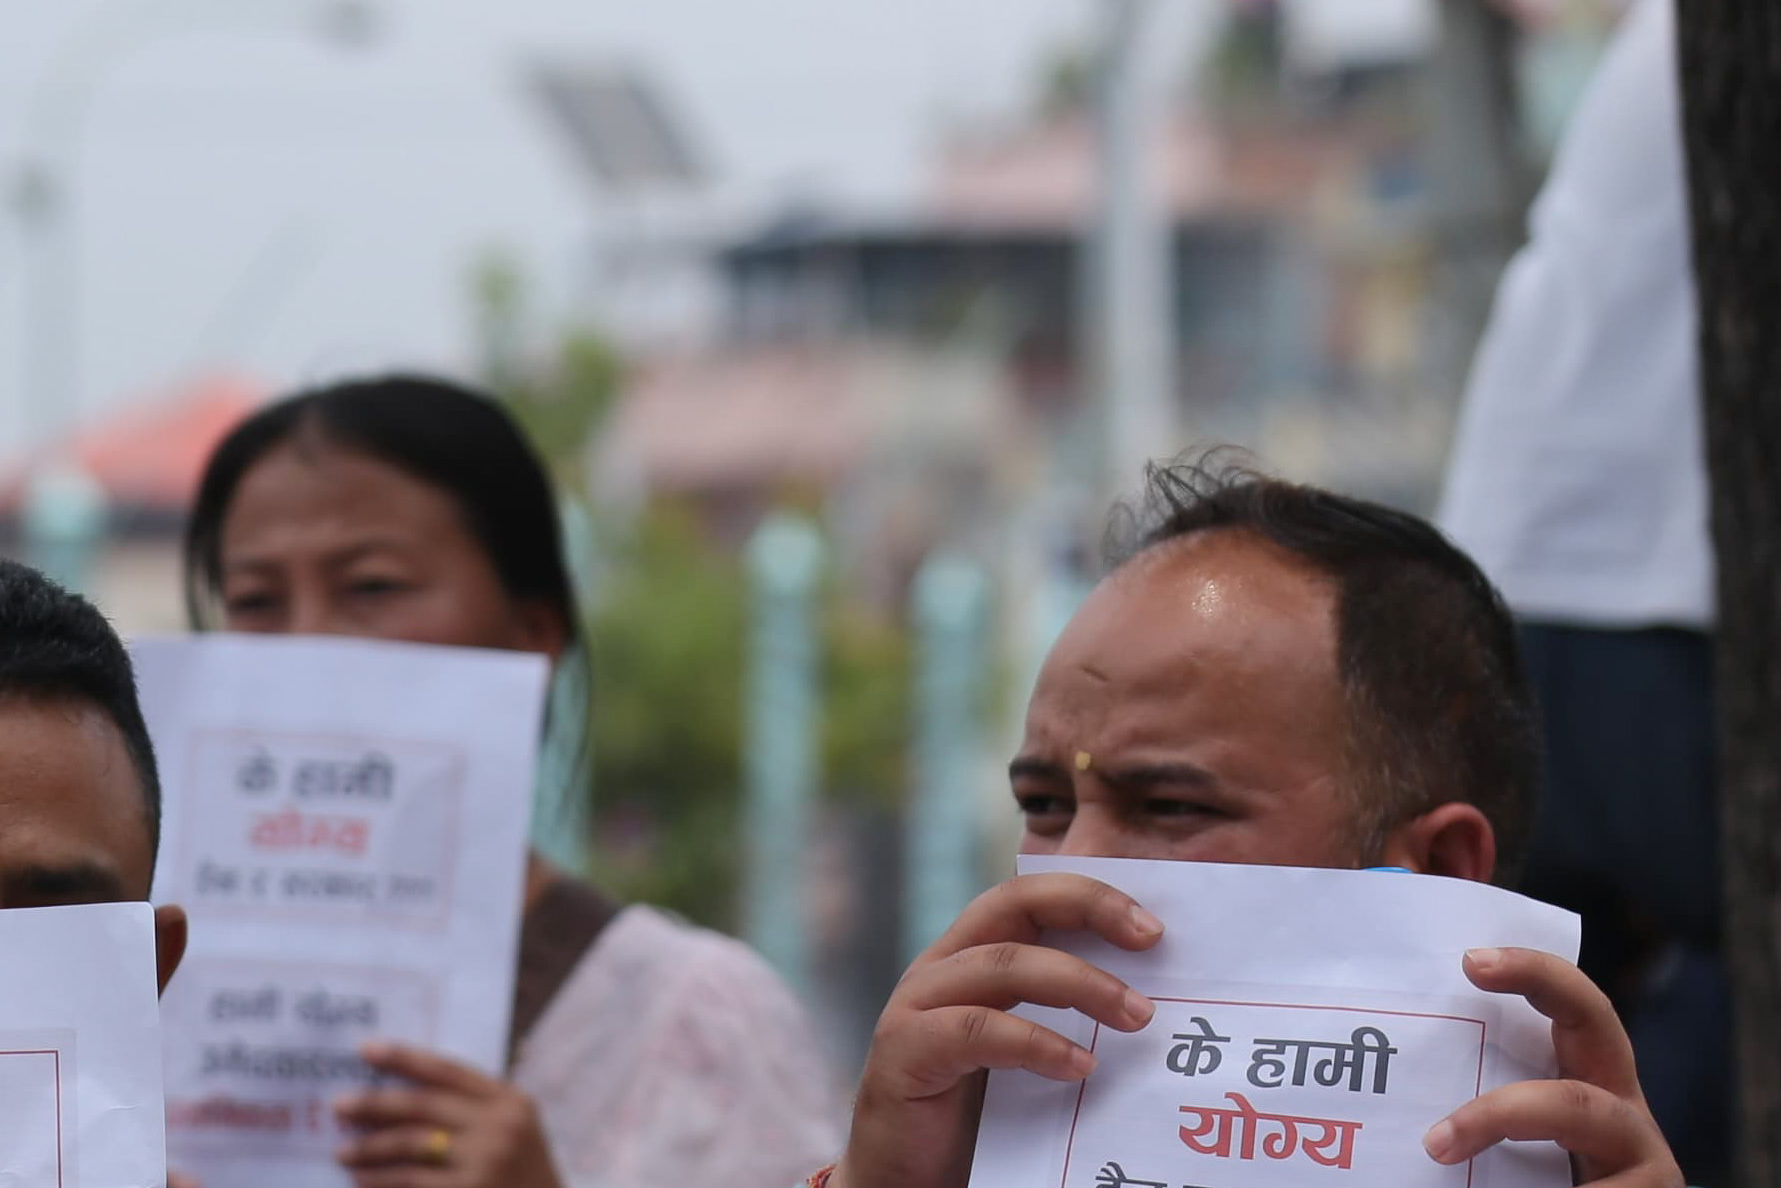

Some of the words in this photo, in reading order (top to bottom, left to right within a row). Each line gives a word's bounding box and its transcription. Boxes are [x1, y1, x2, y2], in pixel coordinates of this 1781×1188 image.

[1166, 1017, 1231, 1076] के
[1247, 1027, 1397, 1094] हामी
[1179, 1092, 1363, 1169] योग्य
